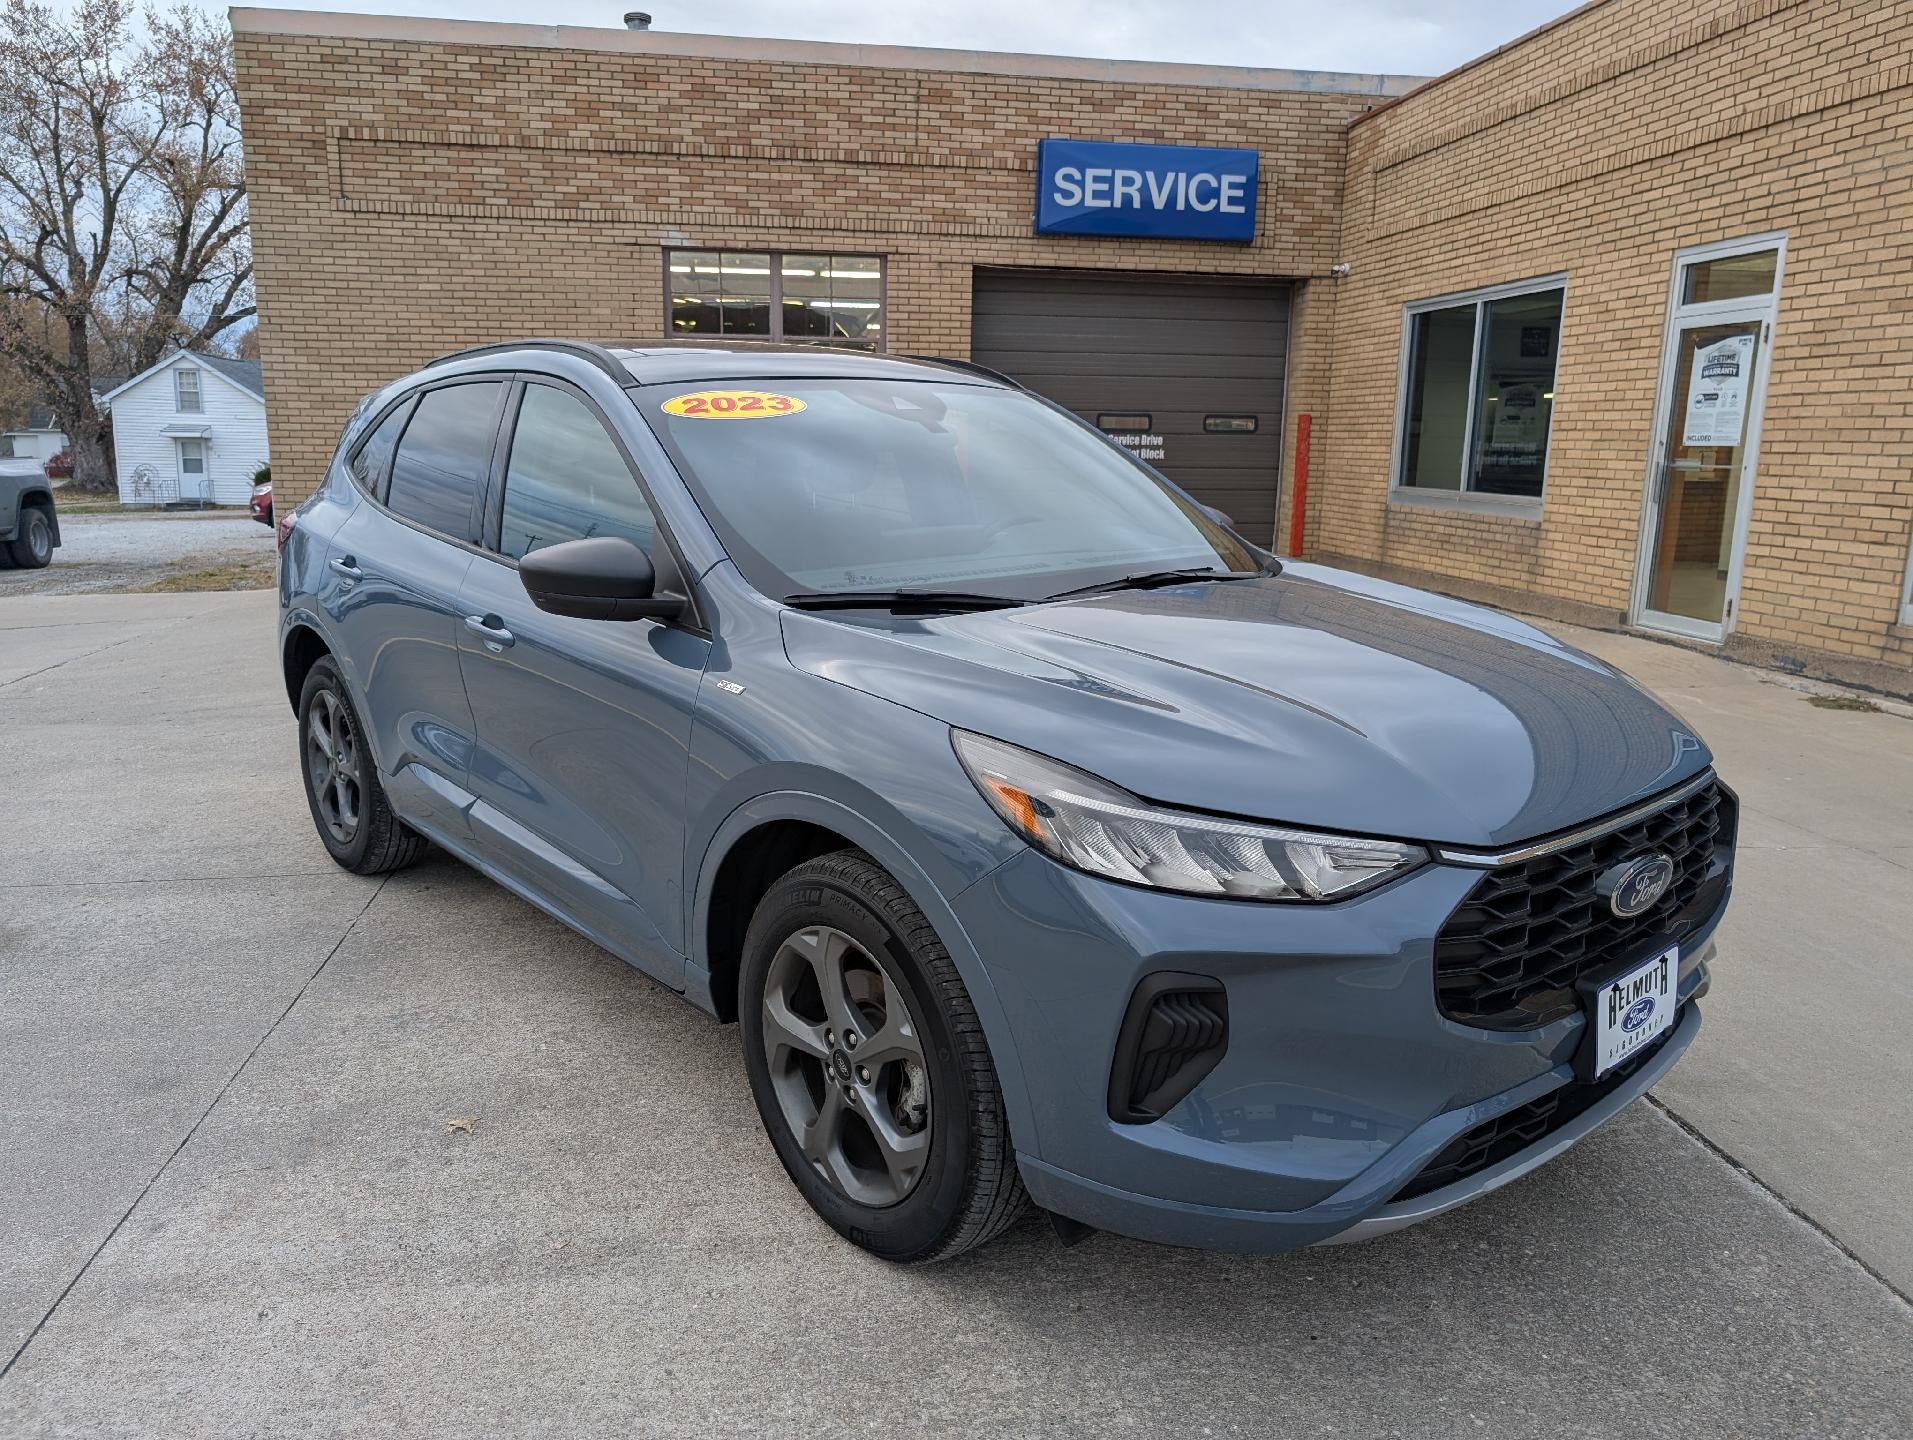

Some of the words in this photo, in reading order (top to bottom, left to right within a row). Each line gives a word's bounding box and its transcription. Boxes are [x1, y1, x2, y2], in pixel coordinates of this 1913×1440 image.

[1053, 166, 1247, 214] SERVICE
[1707, 353, 1737, 363] LIFETIME
[1703, 367, 1737, 377] WARRANTY
[682, 396, 795, 414] 2023
[1141, 434, 1163, 445] Drive
[1140, 448, 1165, 459] Block
[1630, 868, 1665, 907] Ford
[1608, 957, 1668, 1030] HELMUTH
[1627, 1002, 1650, 1030] Ford
